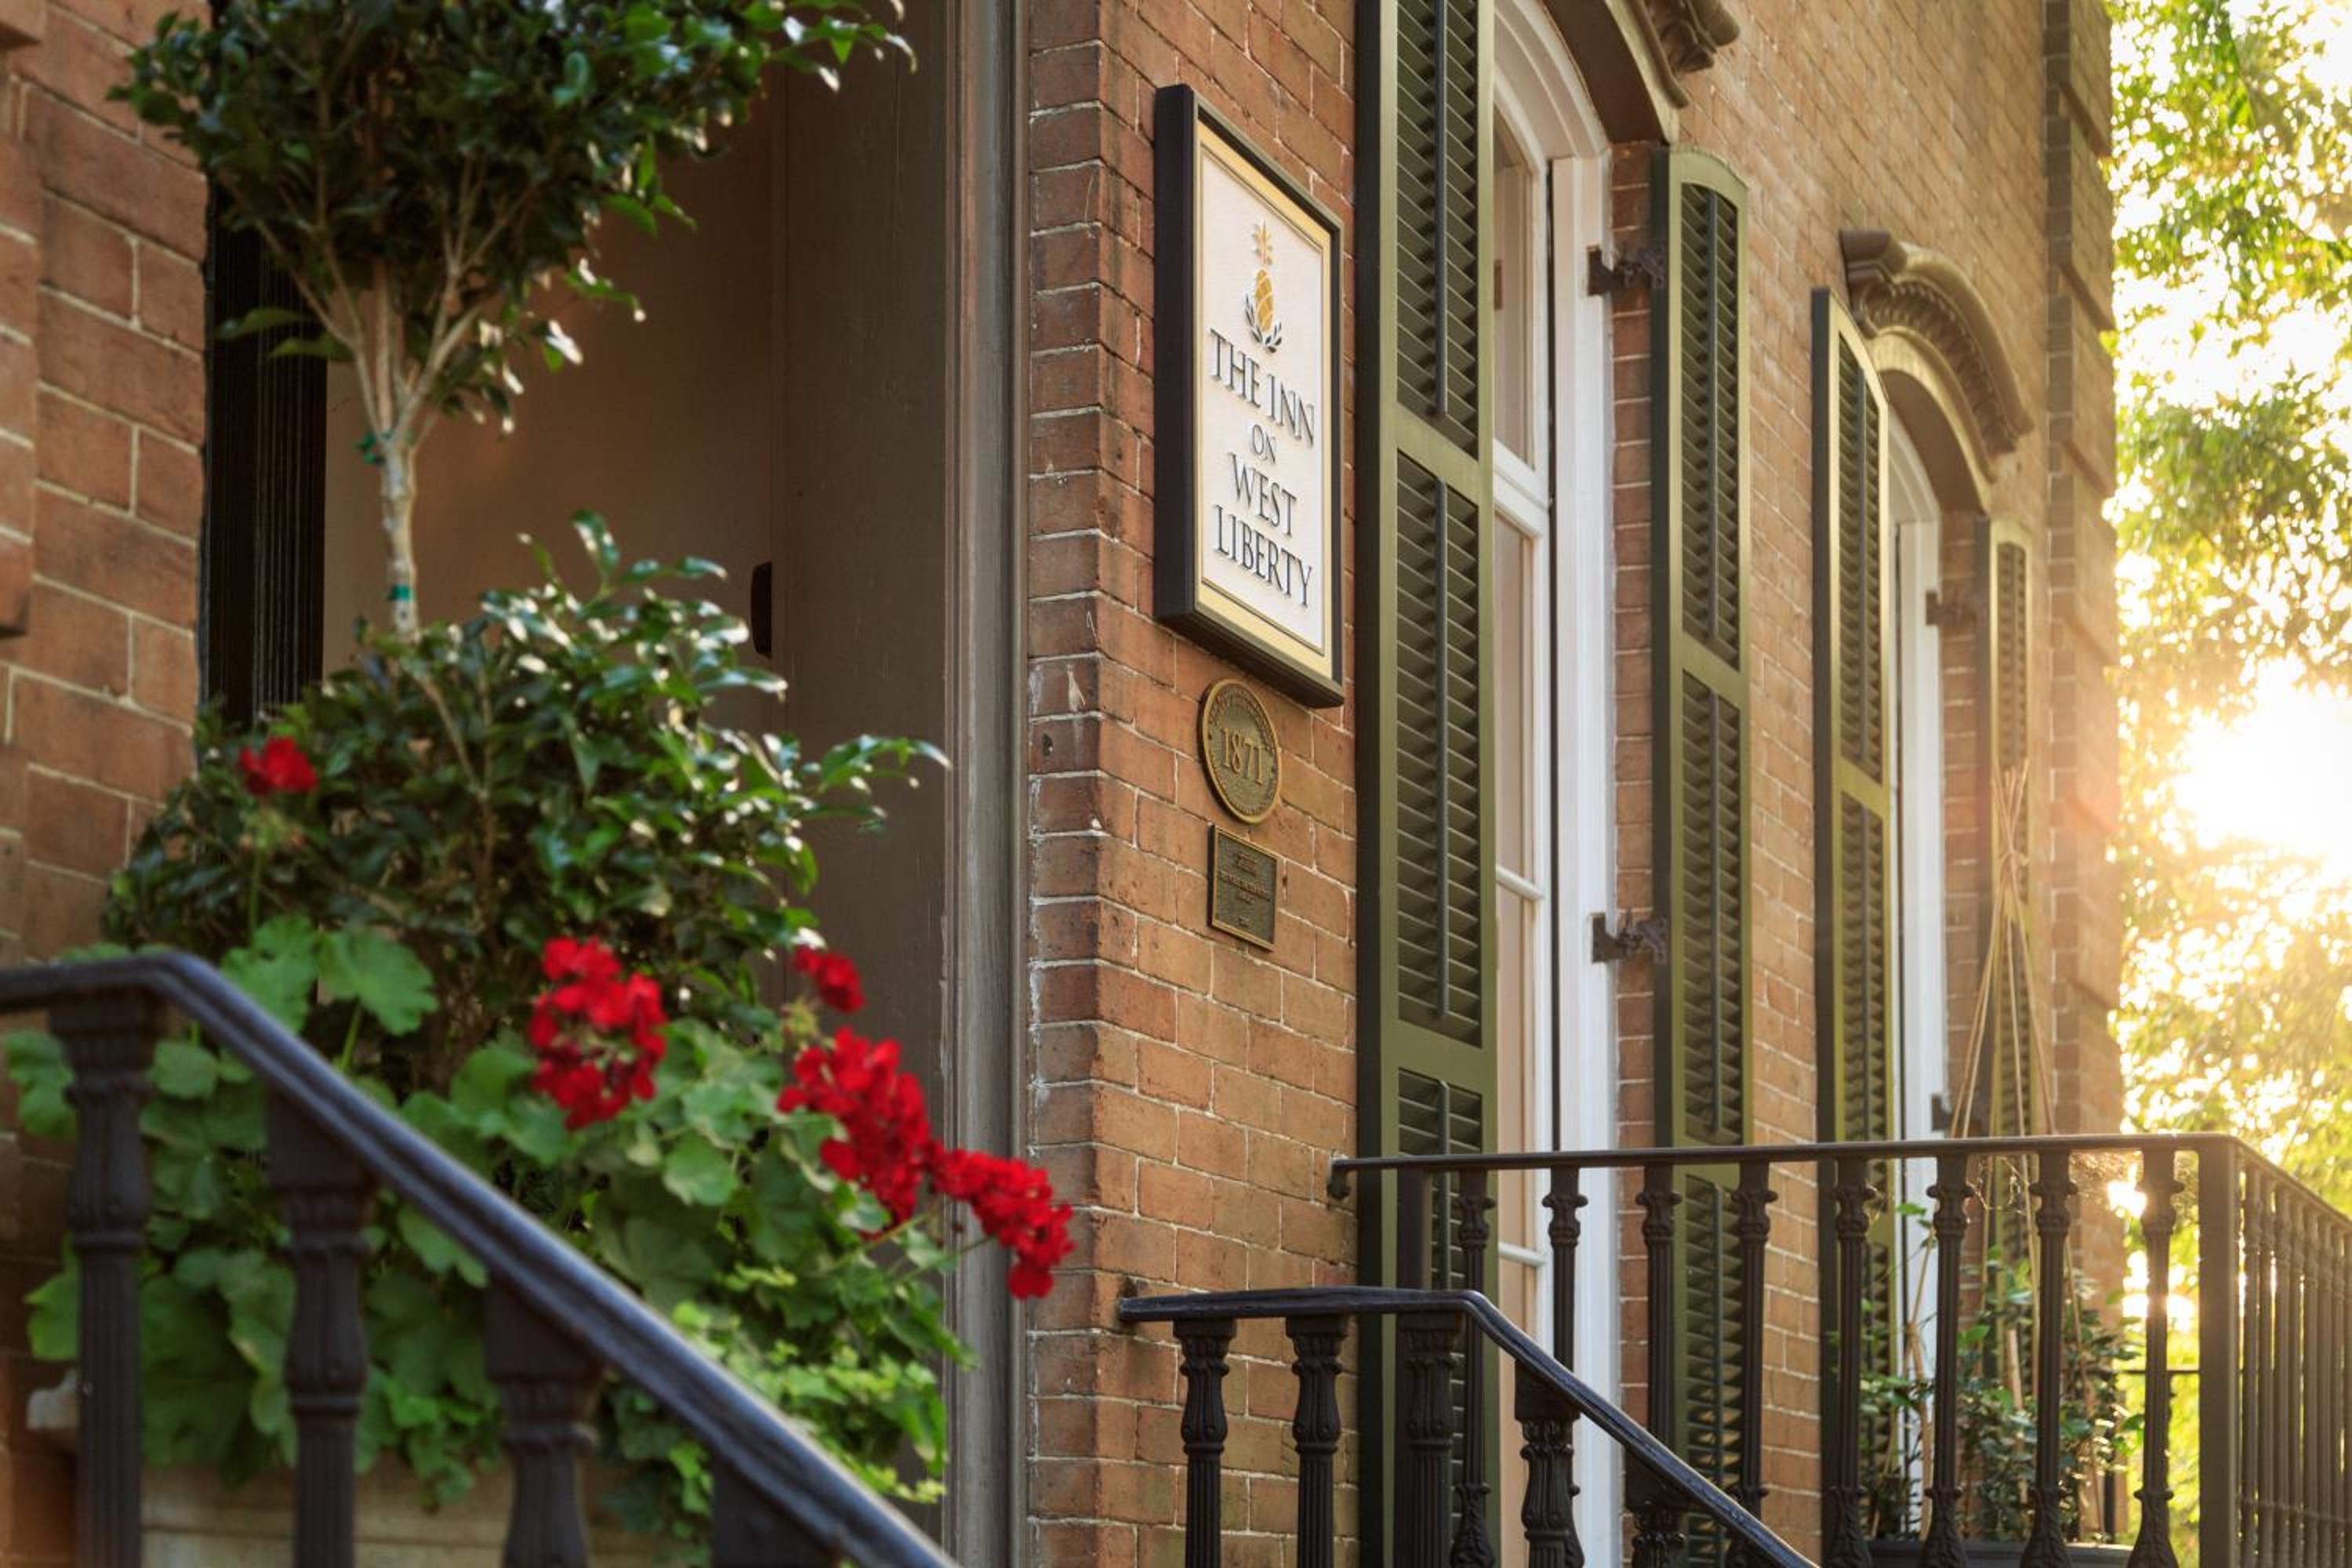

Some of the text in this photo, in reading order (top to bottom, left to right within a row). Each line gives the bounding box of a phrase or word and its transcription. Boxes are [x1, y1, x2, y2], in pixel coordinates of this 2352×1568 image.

[1209, 327, 1315, 448] THE INN
[1252, 424, 1277, 464] ON
[1228, 452, 1298, 537] WEST
[1214, 504, 1313, 608] LIBERTY
[1221, 728, 1262, 786] 1871
